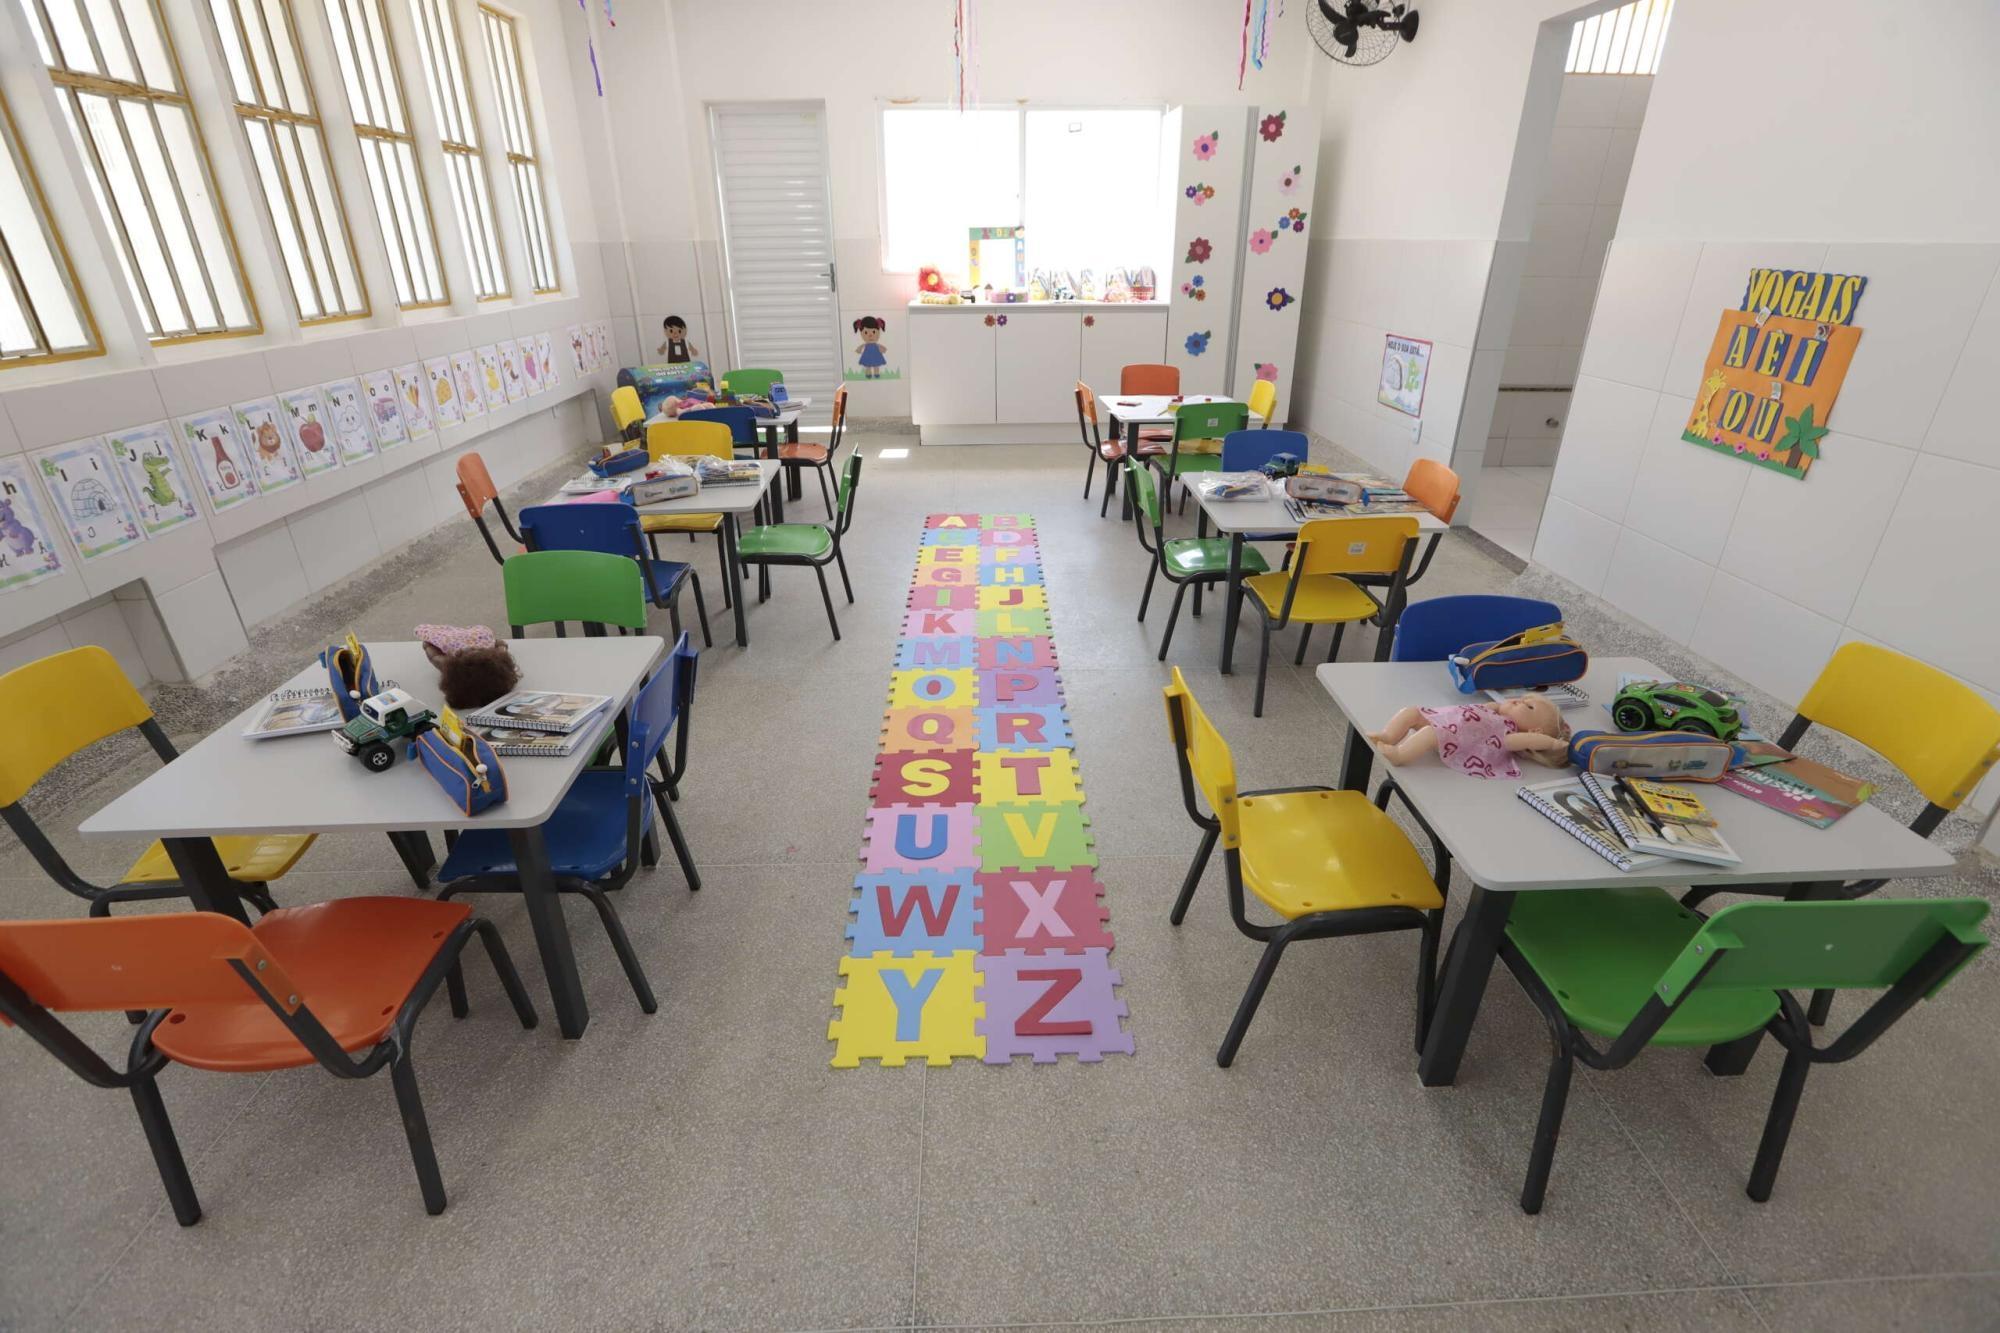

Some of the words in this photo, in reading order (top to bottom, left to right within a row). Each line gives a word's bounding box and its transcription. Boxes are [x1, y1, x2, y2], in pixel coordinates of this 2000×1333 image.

[1747, 268, 1861, 325] VOGAIS
[1726, 326, 1749, 367] A
[1758, 331, 1785, 376] E
[1793, 339, 1821, 385] I
[1722, 391, 1748, 432] O
[1754, 398, 1779, 441] U
[129, 448, 137, 462] J
[3, 481, 17, 495] h
[939, 516, 967, 527] A
[993, 516, 1018, 526] B
[939, 531, 962, 543] C
[993, 531, 1021, 543] D
[934, 548, 963, 562] E
[995, 549, 1020, 562] F
[931, 568, 962, 582] G
[995, 567, 1024, 582] H
[936, 589, 951, 606] I
[999, 589, 1023, 605] J
[922, 613, 956, 634] K
[996, 613, 1029, 633] L
[913, 642, 960, 664] M
[996, 640, 1034, 664] N
[912, 675, 955, 700] O
[996, 673, 1038, 700] P
[907, 713, 955, 744] Q
[996, 712, 1048, 744] R
[901, 759, 952, 797] S
[1001, 757, 1050, 795] T
[895, 814, 948, 860] U
[1003, 813, 1058, 857] V
[876, 885, 961, 937] W
[1009, 880, 1075, 938] X
[878, 969, 944, 1041] Y
[1014, 969, 1092, 1036] Z
